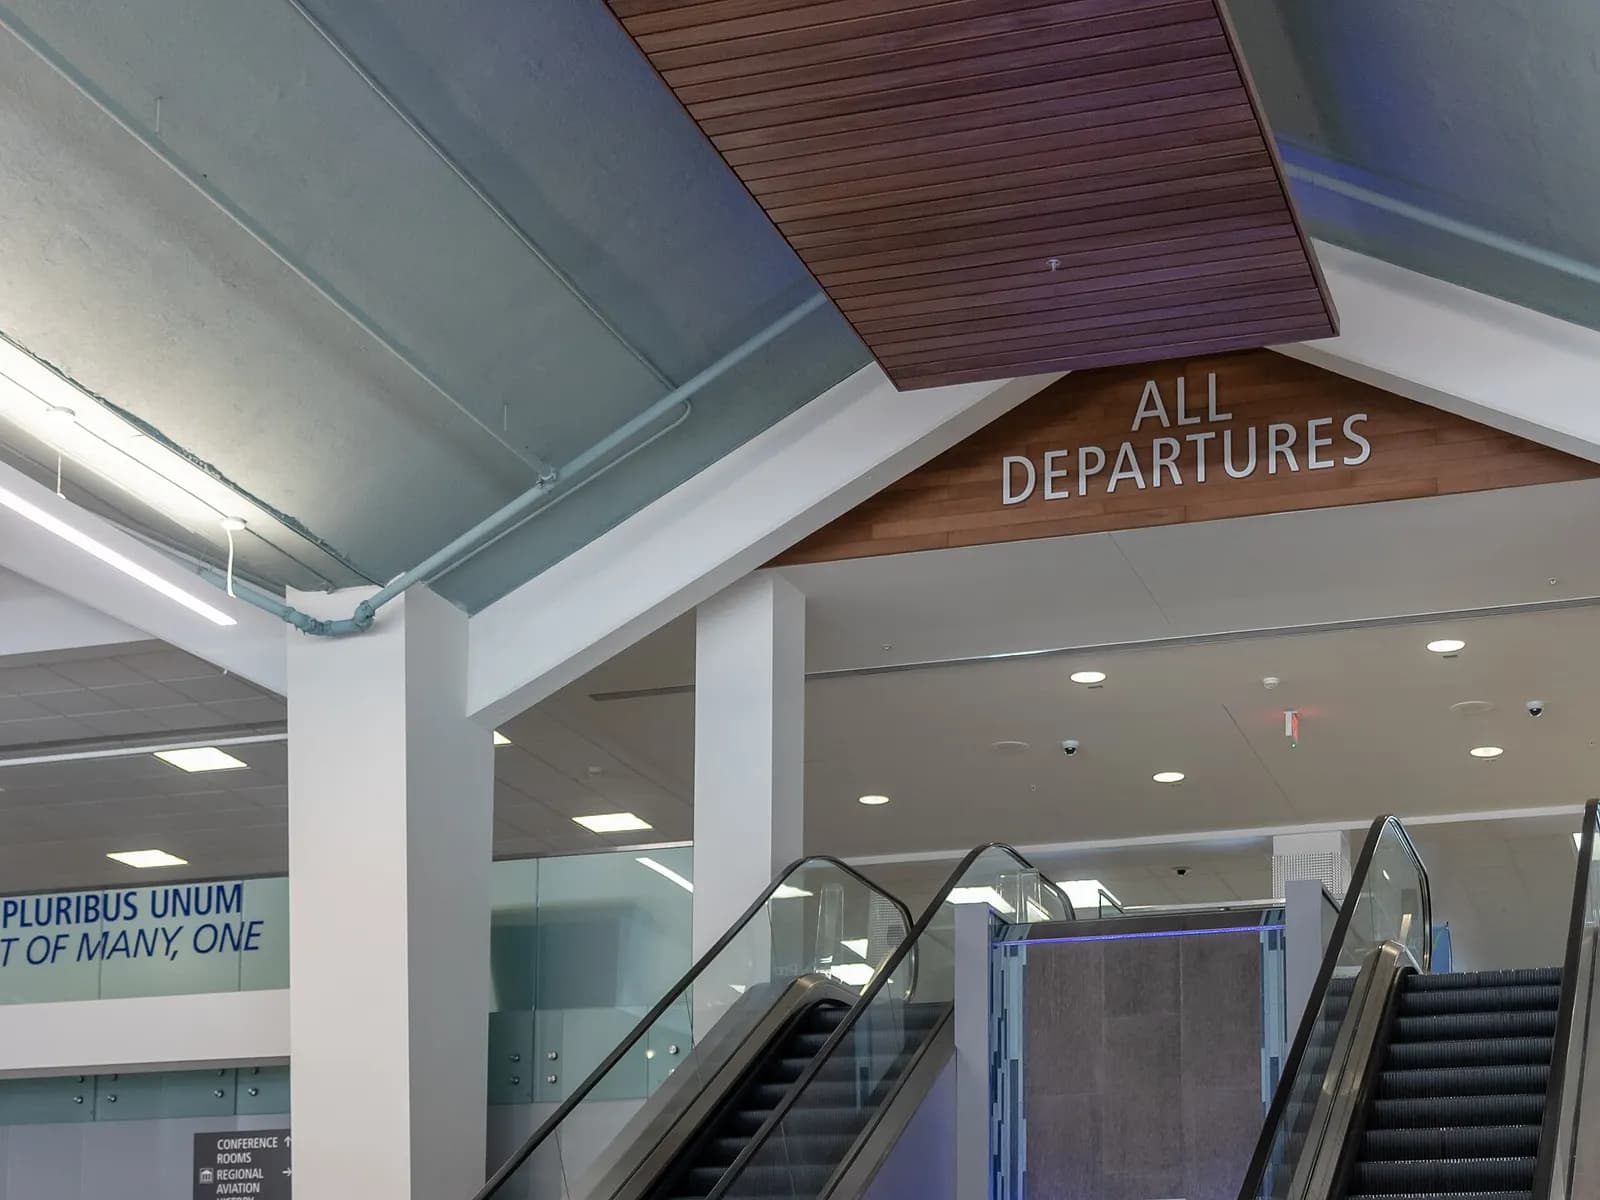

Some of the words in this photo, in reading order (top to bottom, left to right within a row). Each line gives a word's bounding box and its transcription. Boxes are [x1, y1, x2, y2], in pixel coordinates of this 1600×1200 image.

[1131, 372, 1233, 432] ALL
[1002, 413, 1372, 505] DEPARTURES
[3, 891, 137, 928] PLURIBUS
[151, 883, 243, 919] UNUM
[26, 934, 69, 965] OF
[76, 925, 184, 962] MANY,
[192, 920, 264, 954] ONE
[217, 1137, 278, 1150] CONFERENCE
[217, 1152, 251, 1164] ROOMS
[216, 1183, 260, 1194] AVIATION
[217, 1168, 264, 1180] REGIONAL
